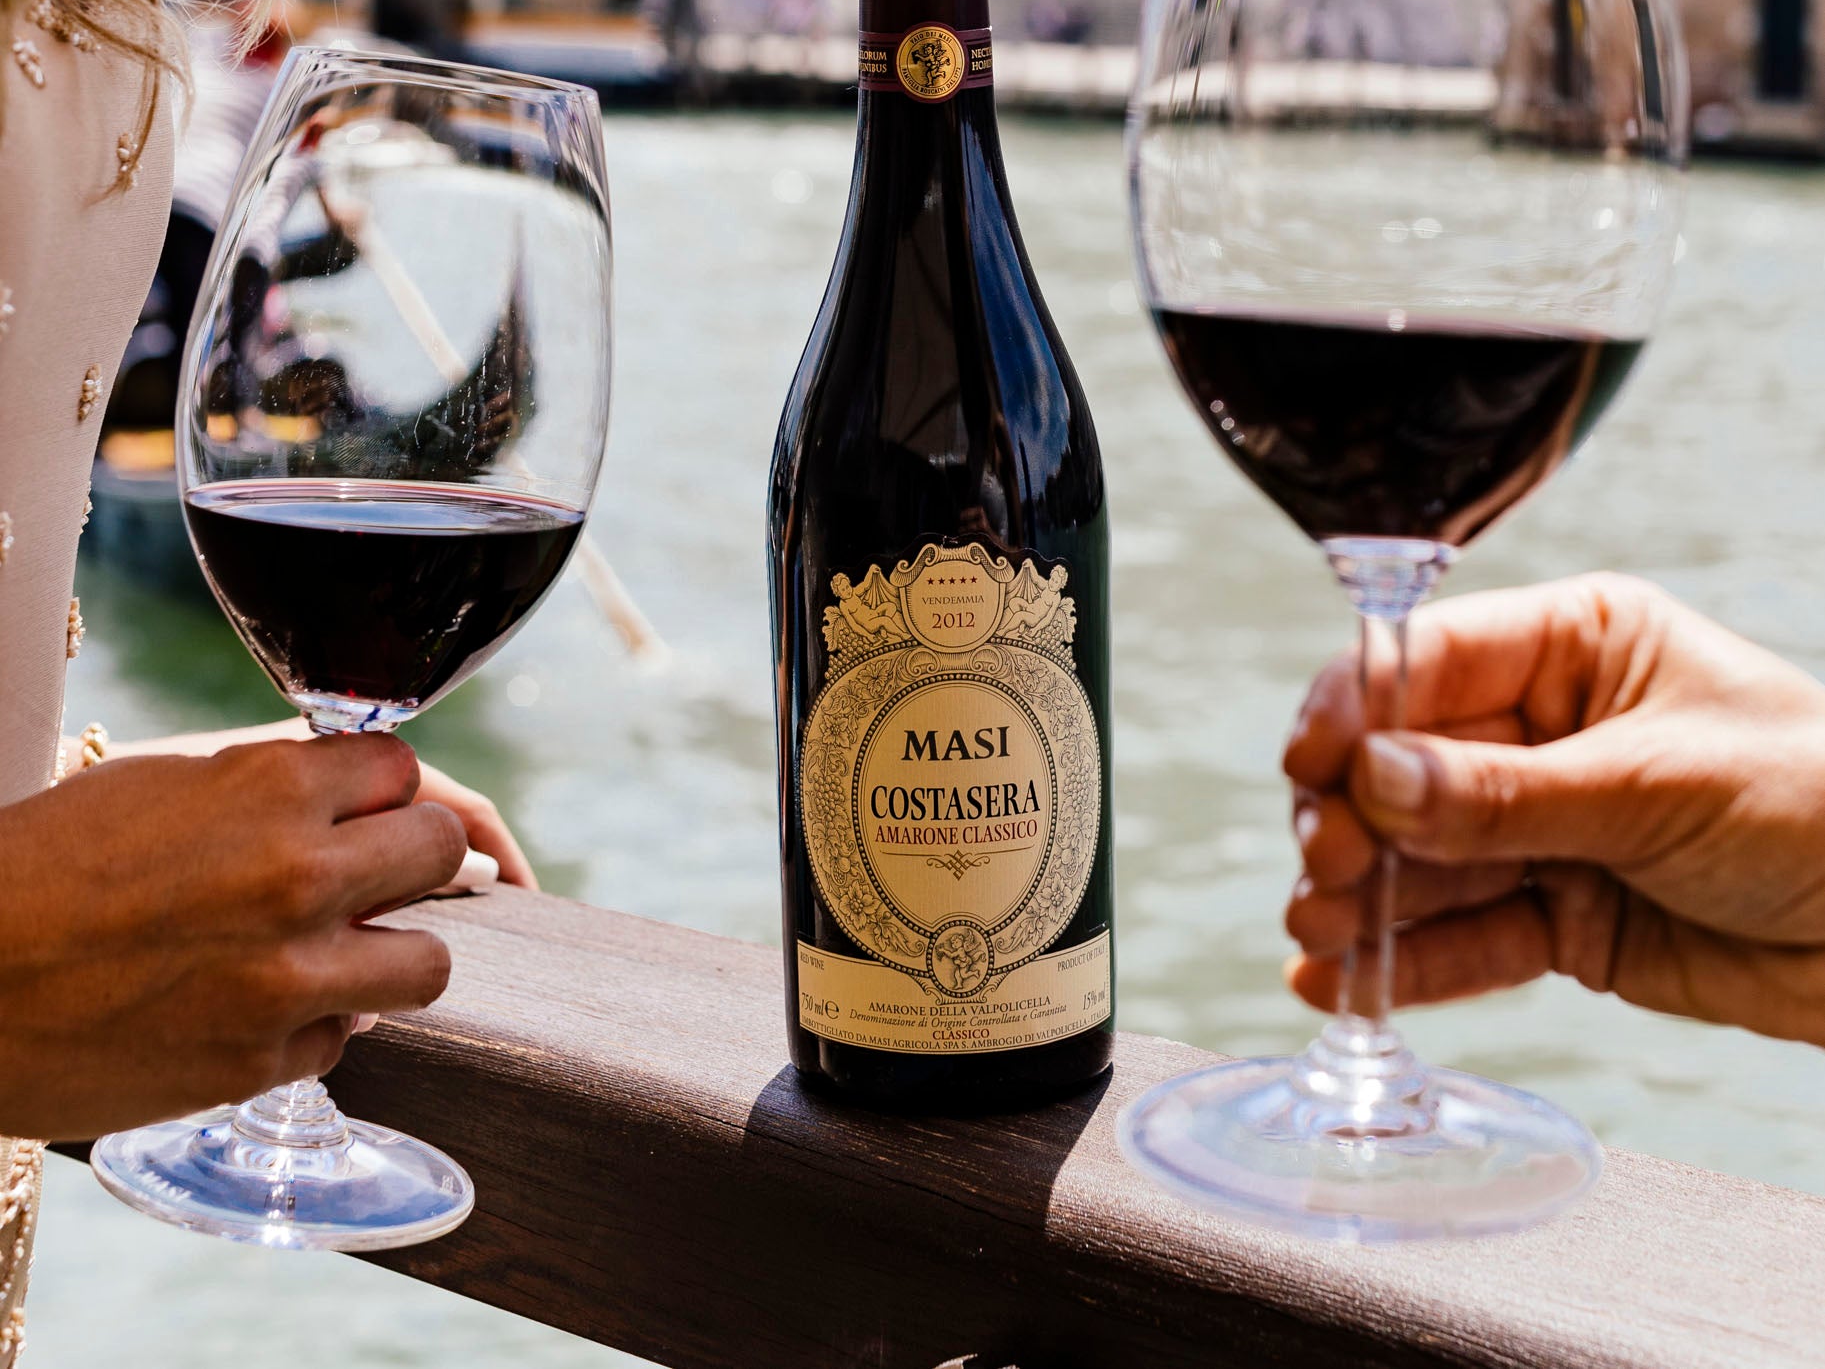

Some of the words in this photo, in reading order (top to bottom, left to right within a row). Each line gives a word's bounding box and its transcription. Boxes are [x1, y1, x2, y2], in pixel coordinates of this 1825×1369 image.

[921, 595, 985, 605] VENDEMMIA
[932, 611, 976, 629] 2012
[901, 725, 1011, 762] MASI
[870, 779, 1041, 821] COSTASERA
[875, 825, 959, 845] AMARONE
[962, 818, 1038, 844] CLASSICO
[809, 955, 825, 971] WINE
[1057, 953, 1086, 972] PRODUCT
[1086, 949, 1094, 962] OF
[801, 992, 814, 1011] 750
[814, 998, 825, 1016] ml
[868, 1001, 926, 1016] AMARONE
[929, 1006, 967, 1017] DELLA
[970, 995, 1051, 1016] VALPOLICELLA
[1082, 990, 1098, 1011] 15%
[850, 1008, 916, 1028] Denominazione
[918, 1016, 928, 1028] di
[931, 1017, 967, 1031] Origine
[969, 1012, 1021, 1027] Controllata
[1022, 1014, 1028, 1022] e
[1030, 1004, 1067, 1021] Garantita
[856, 1033, 867, 1043] DA
[869, 1035, 890, 1047] MASI
[892, 1039, 941, 1050] AGRICOLA
[943, 1041, 960, 1050] SPA
[961, 1041, 969, 1050] S.
[971, 1035, 1023, 1049] AMBROGIO
[1024, 1033, 1035, 1043] DI
[1036, 1018, 1088, 1041] VALPOLICELLA
[1090, 1007, 1107, 1022] ITALIA
[932, 1028, 990, 1041] CLASSICO
